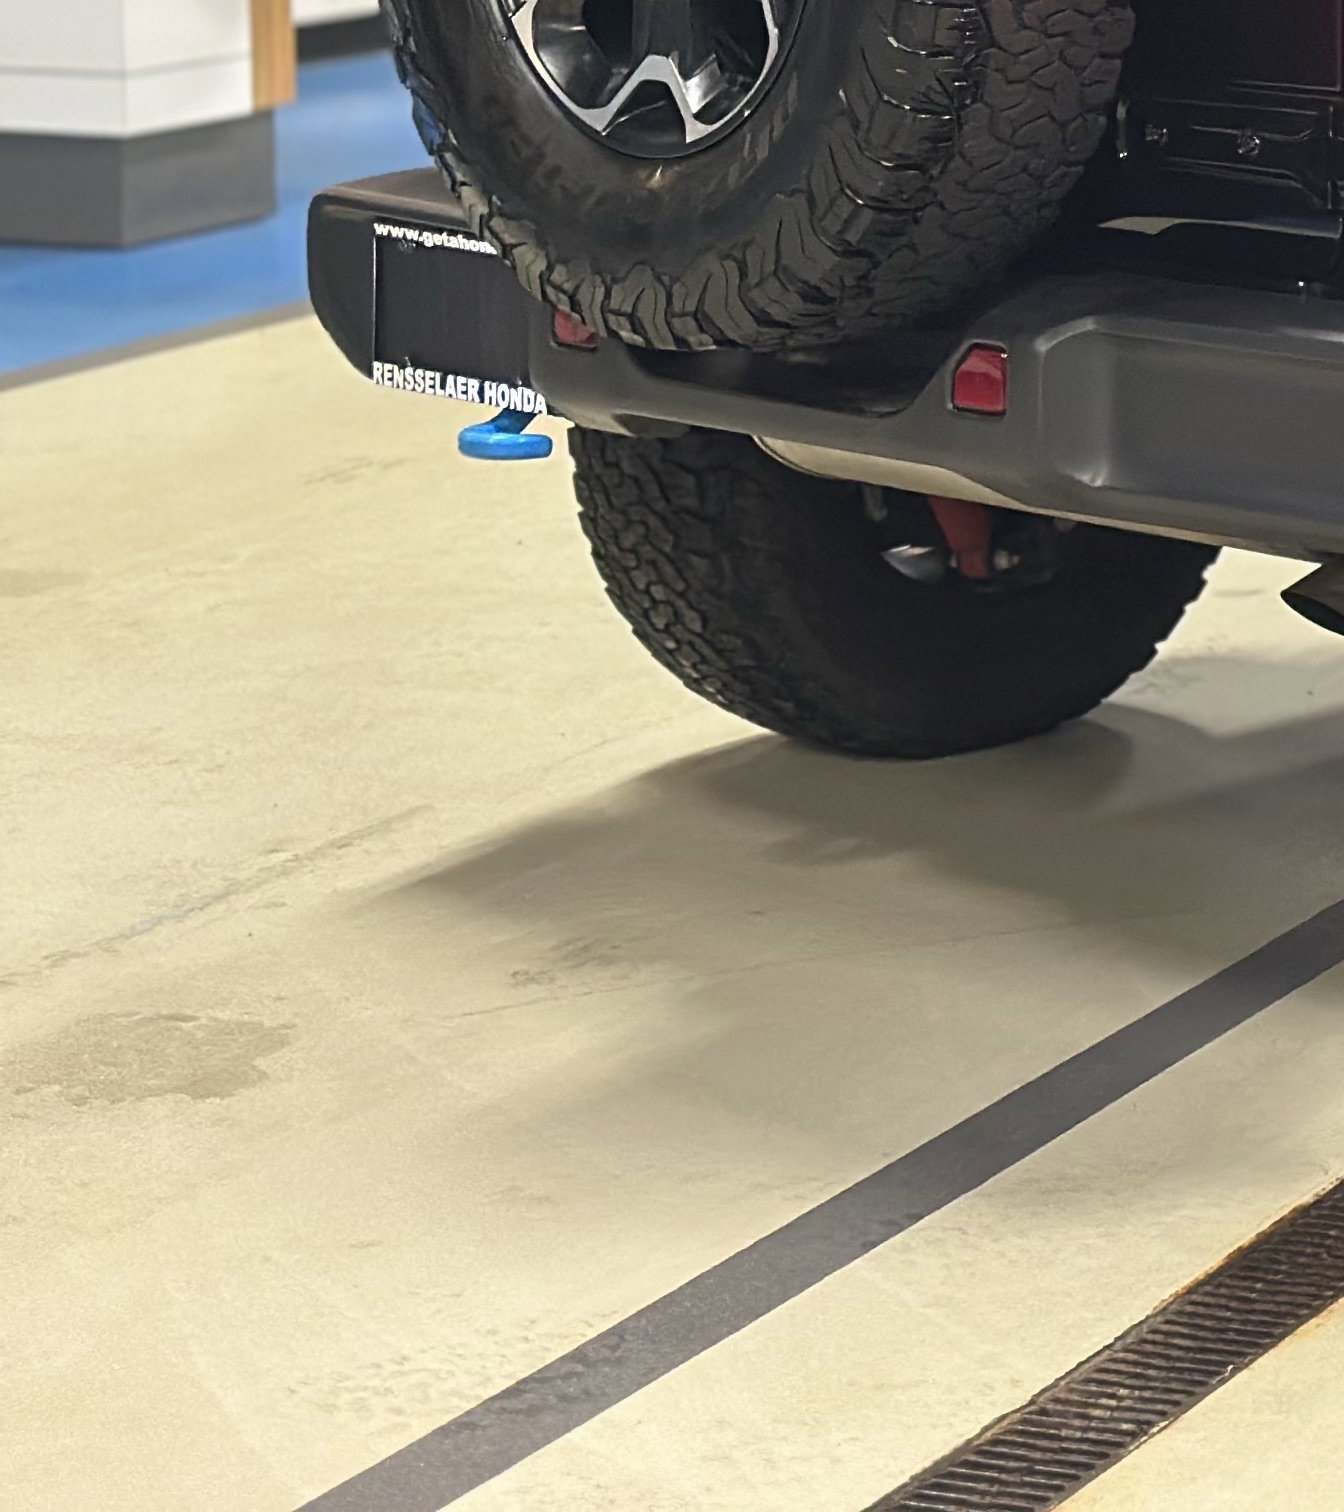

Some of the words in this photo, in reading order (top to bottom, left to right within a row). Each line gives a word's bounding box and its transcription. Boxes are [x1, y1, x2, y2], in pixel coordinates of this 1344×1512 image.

[373, 222, 498, 256] www.getahon
[372, 359, 481, 406] RENSSELAER
[483, 379, 549, 416] HONDA
